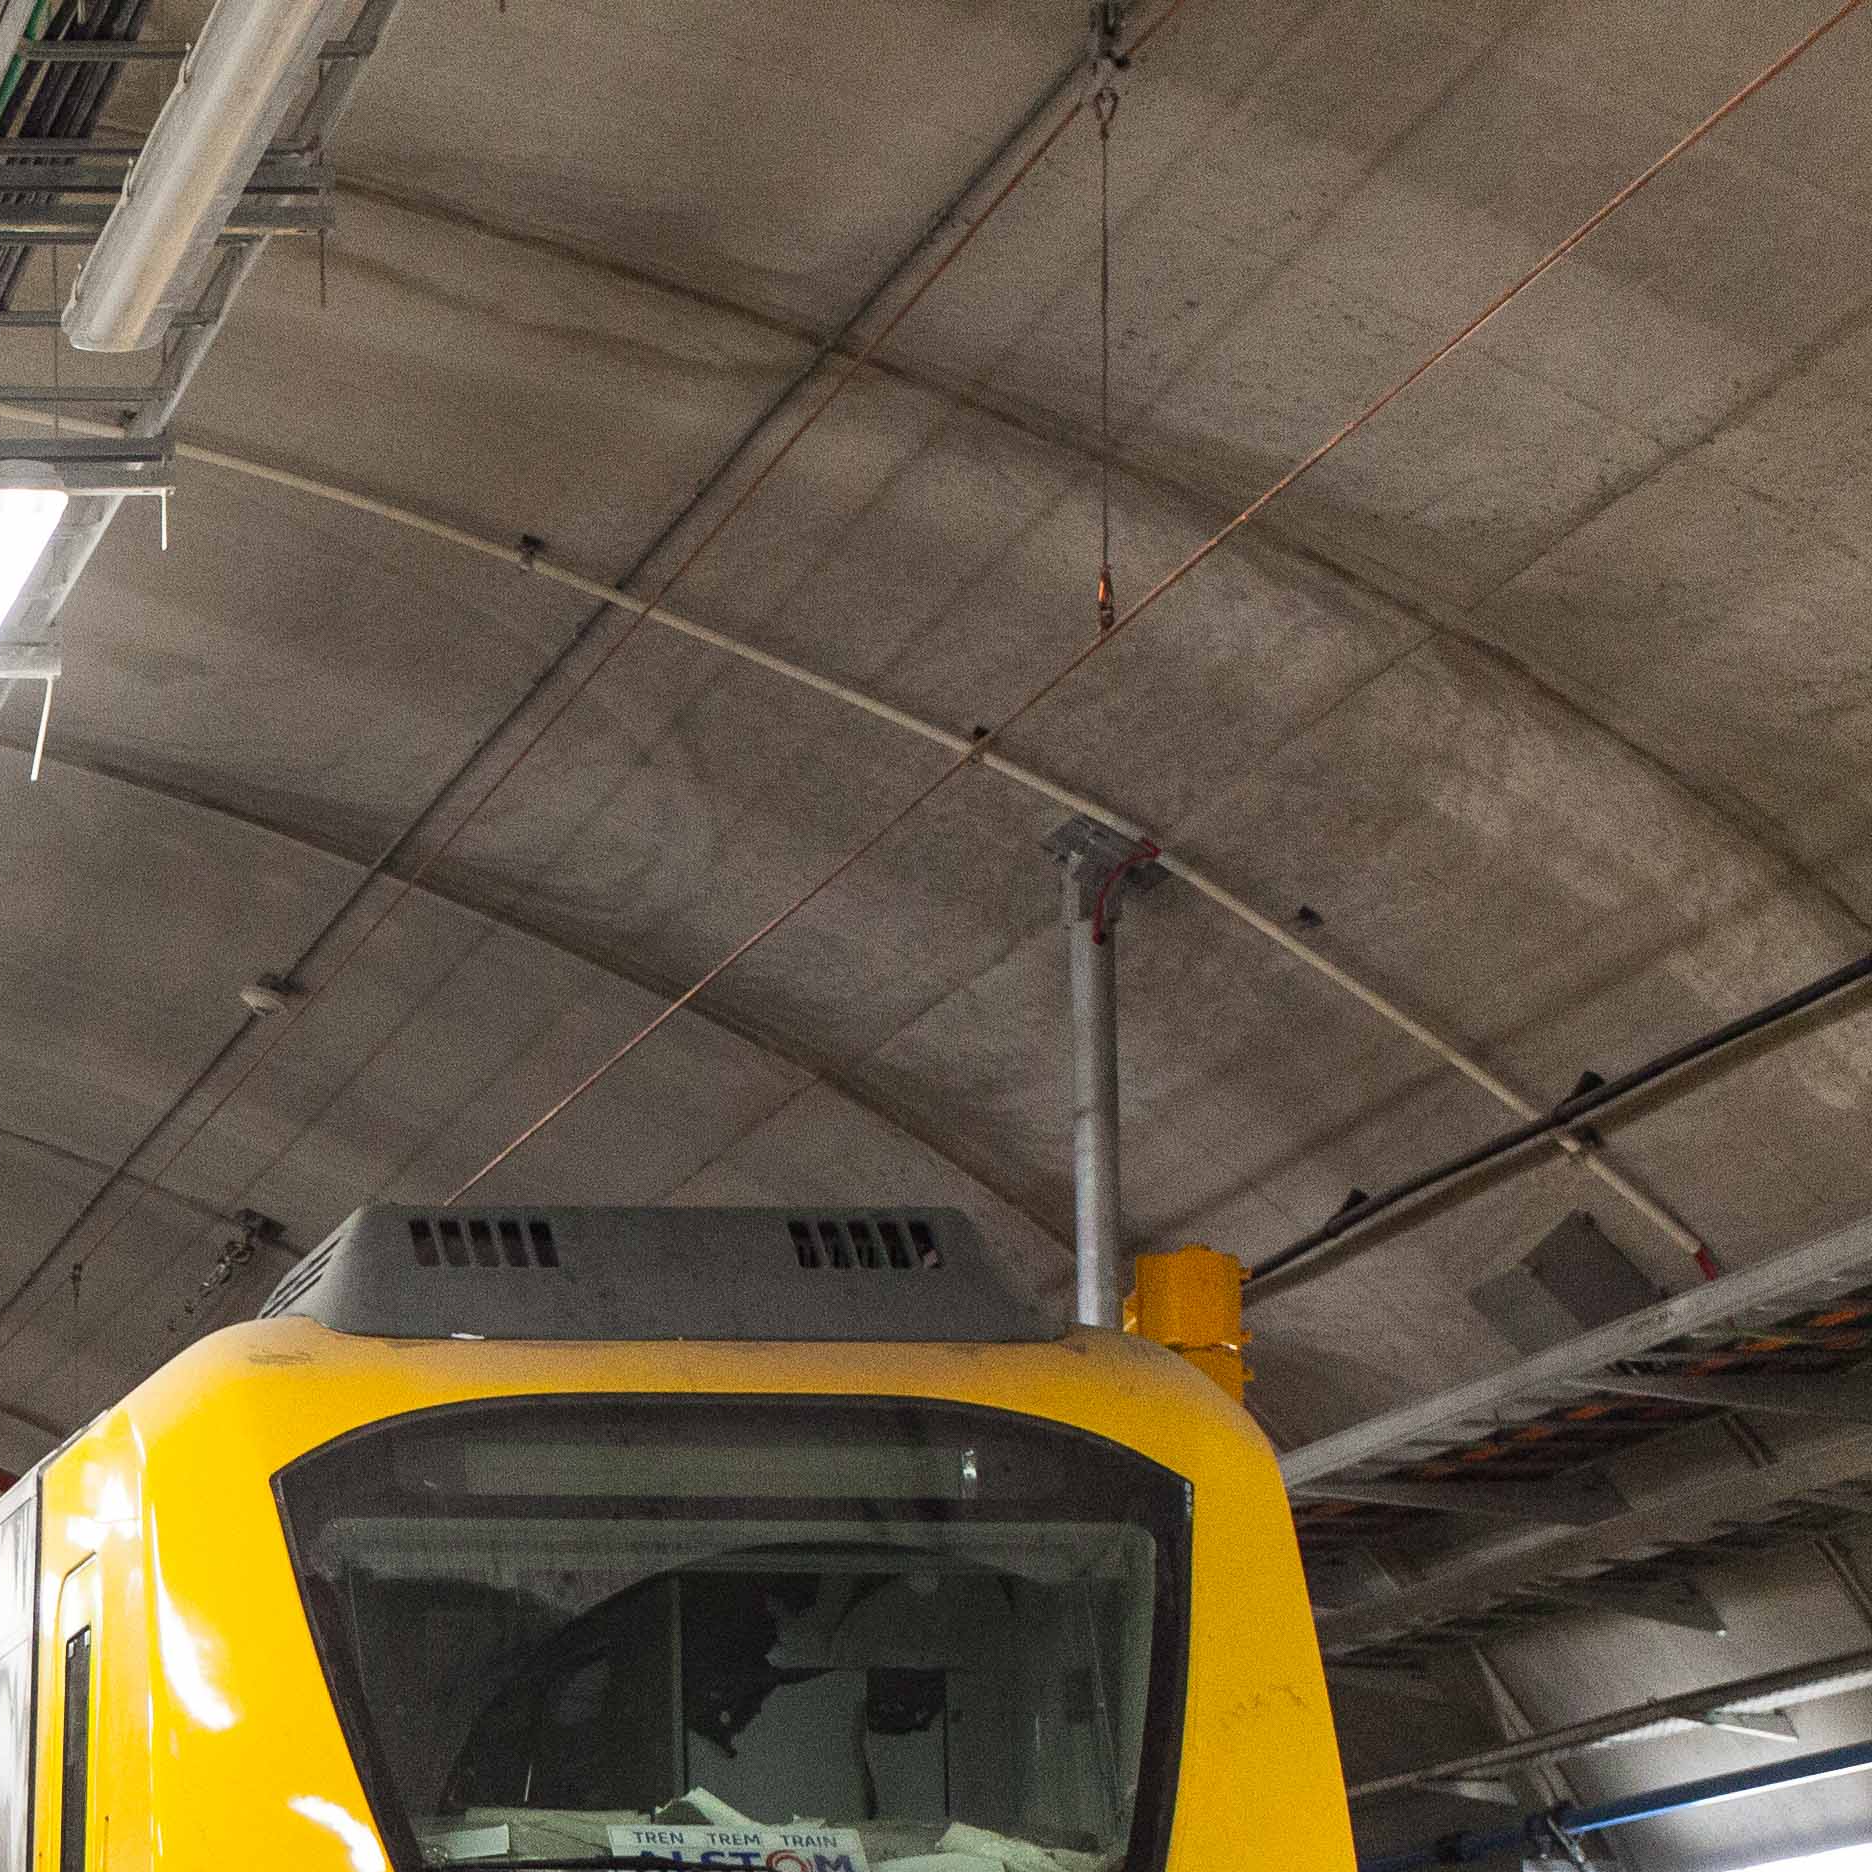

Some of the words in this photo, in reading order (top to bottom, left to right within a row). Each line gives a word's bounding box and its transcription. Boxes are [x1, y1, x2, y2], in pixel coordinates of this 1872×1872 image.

[633, 1830, 685, 1845] TREN
[706, 1832, 761, 1847] TREM
[780, 1833, 838, 1849] TRAIN
